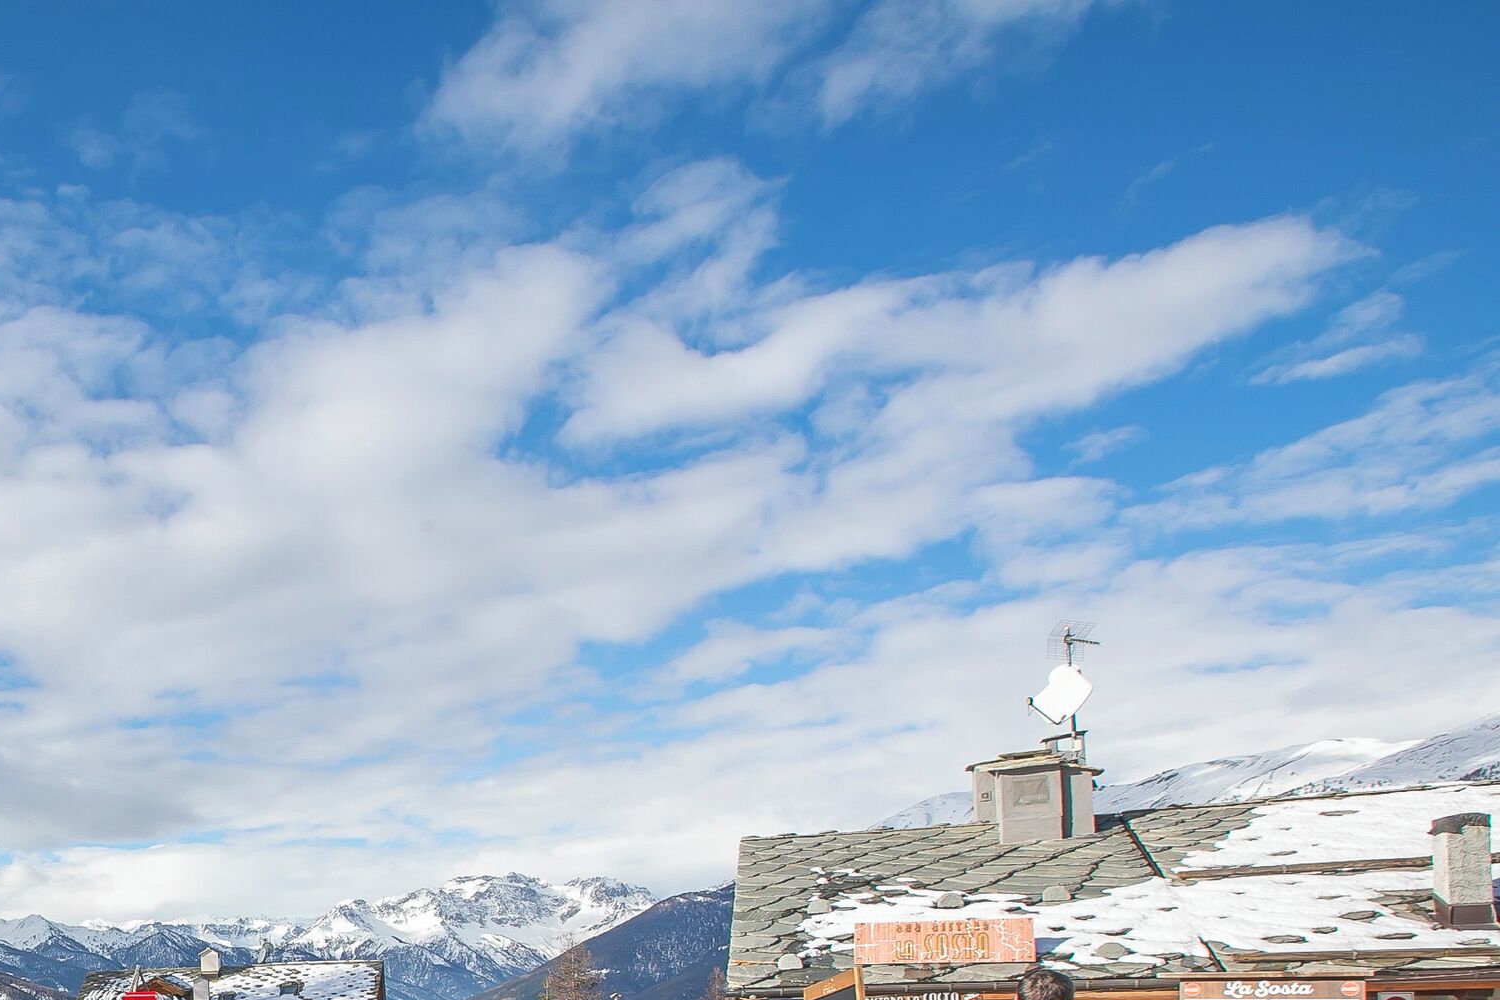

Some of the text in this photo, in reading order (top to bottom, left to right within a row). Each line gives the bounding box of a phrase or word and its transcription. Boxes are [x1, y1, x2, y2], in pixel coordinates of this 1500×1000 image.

[895, 931, 990, 960] LA SOSTA
[1223, 981, 1314, 998] La Sosta
